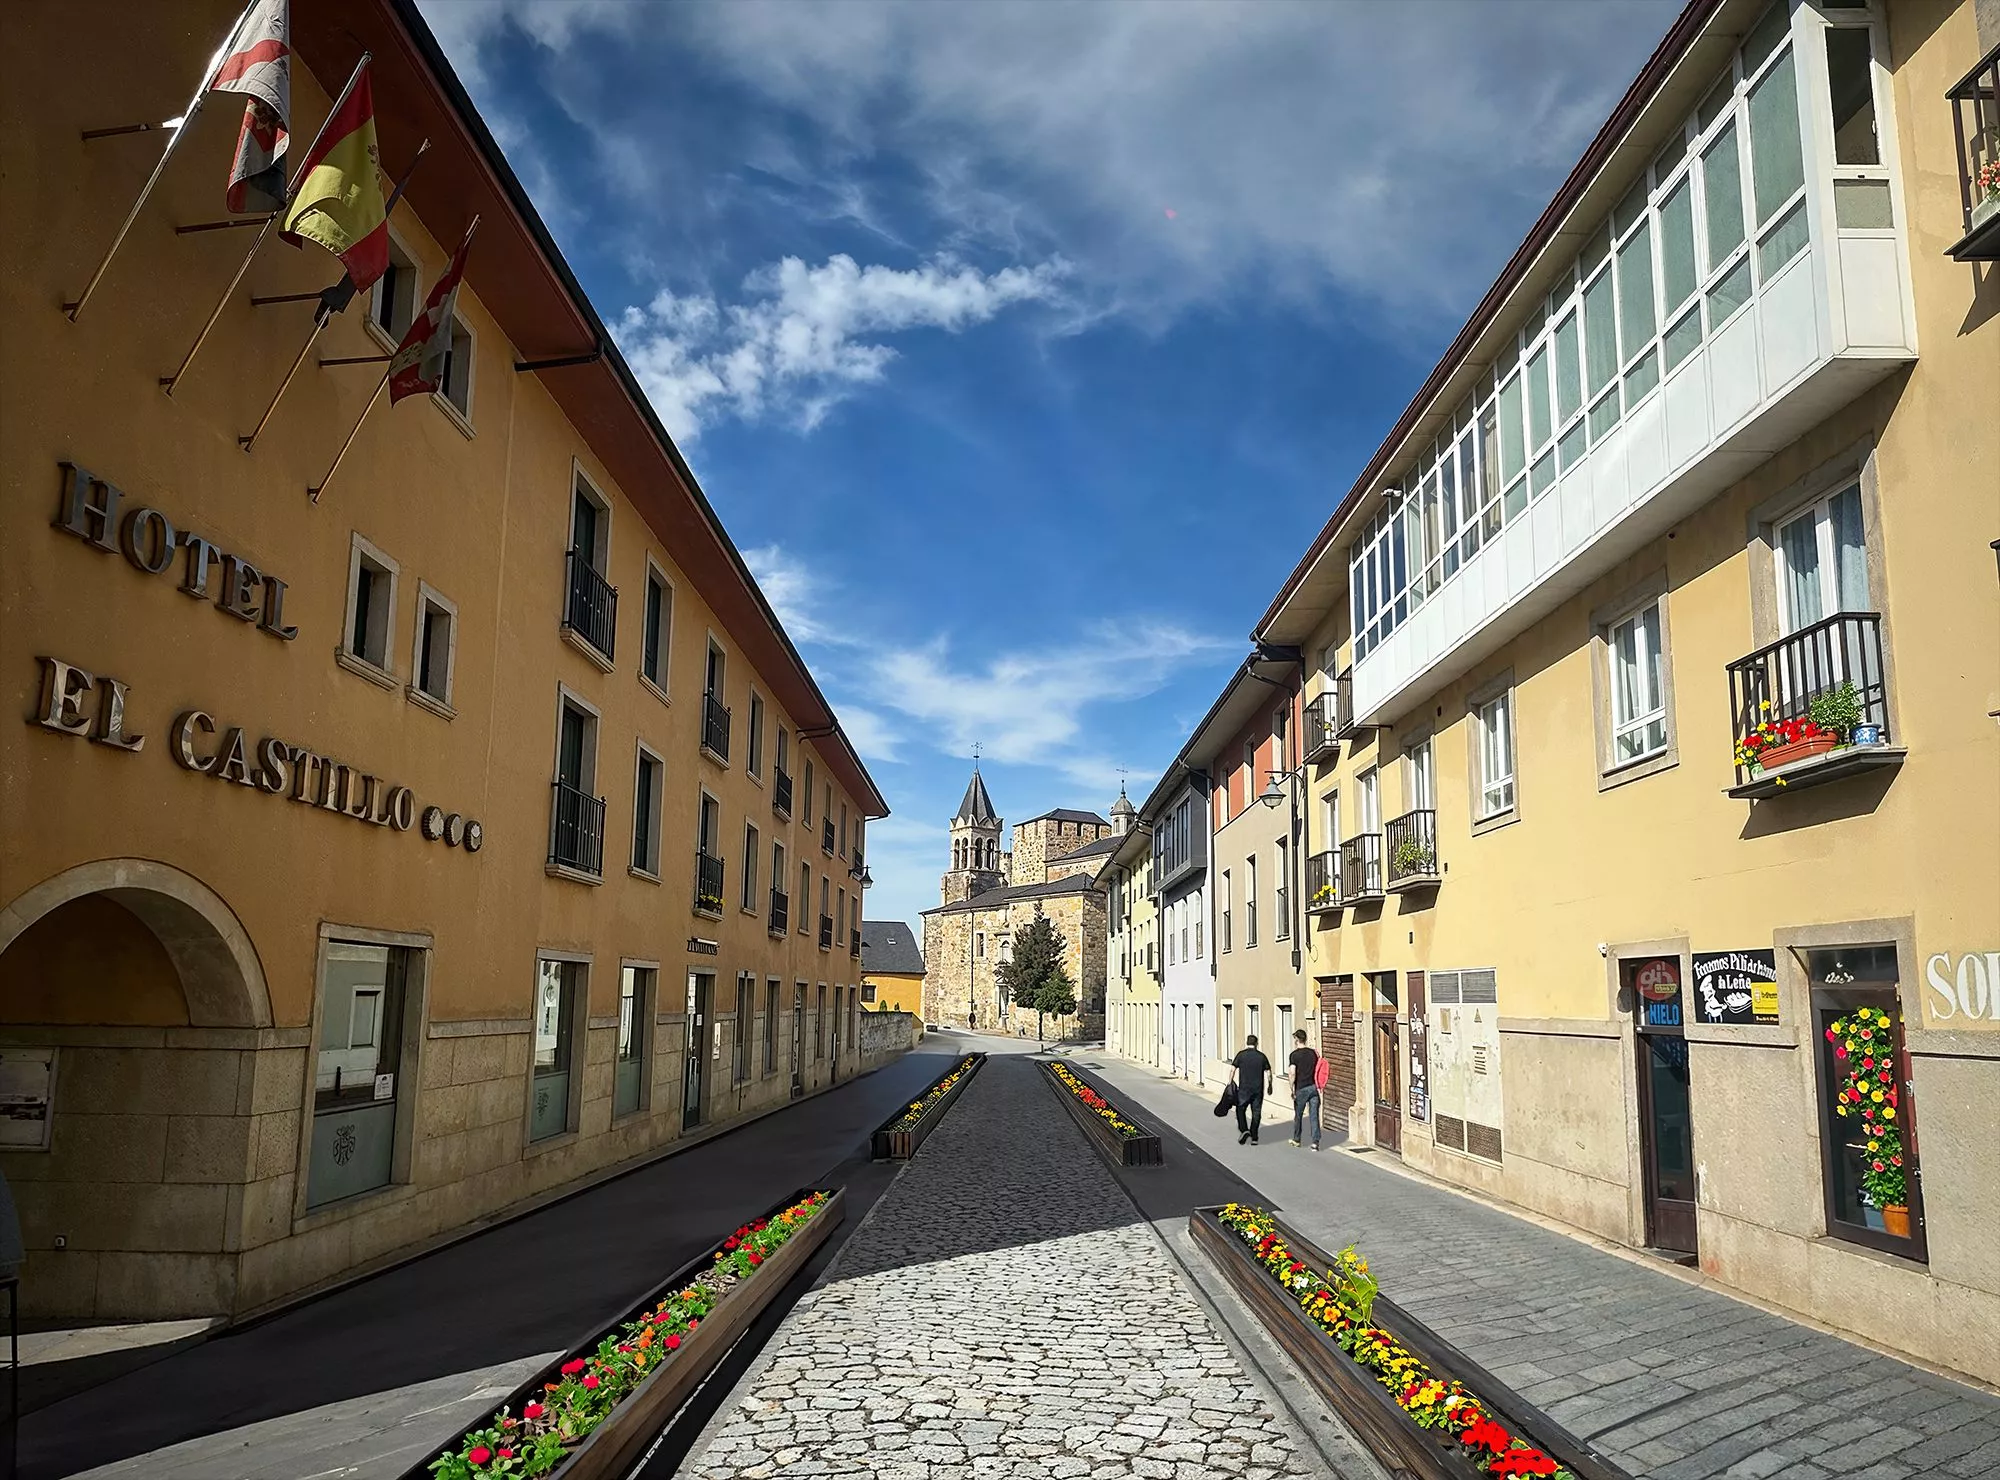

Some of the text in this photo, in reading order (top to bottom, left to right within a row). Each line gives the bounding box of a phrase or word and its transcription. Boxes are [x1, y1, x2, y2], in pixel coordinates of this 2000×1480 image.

[51, 461, 299, 641] HOTEL
[27, 656, 416, 831] EL CASTILLO
